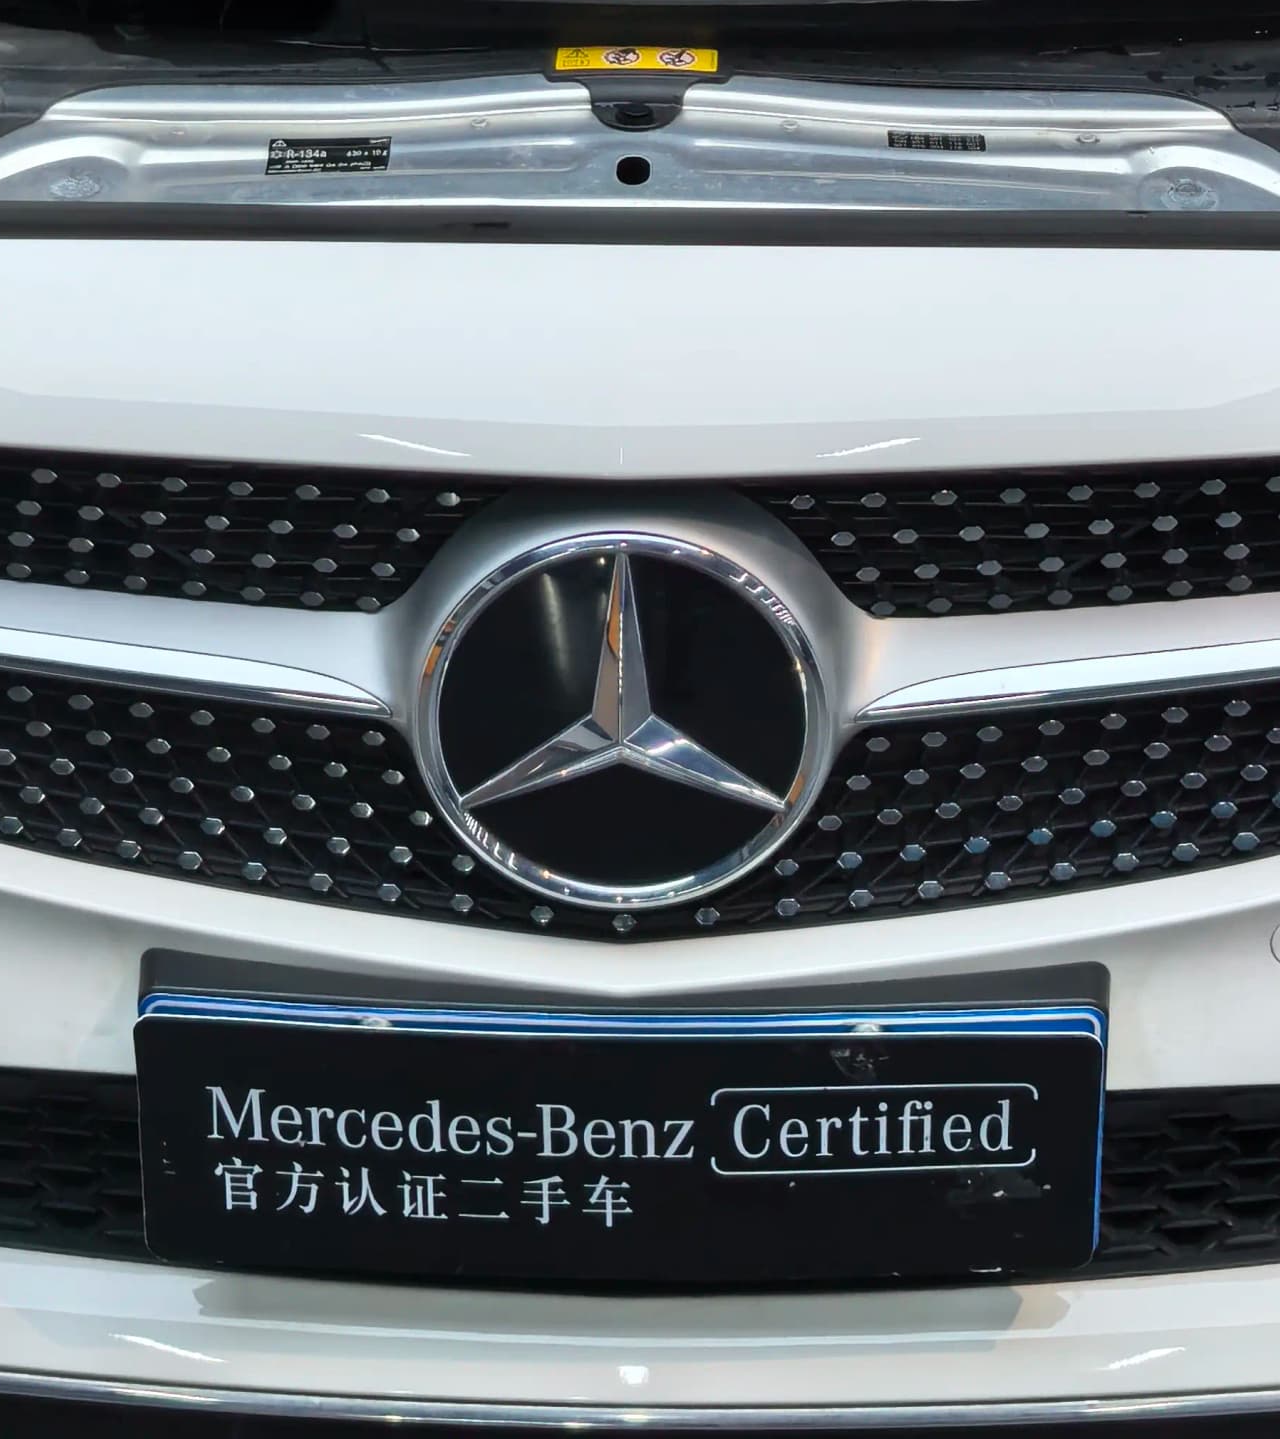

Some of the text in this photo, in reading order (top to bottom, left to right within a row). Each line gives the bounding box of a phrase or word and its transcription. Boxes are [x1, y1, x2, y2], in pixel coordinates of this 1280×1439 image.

[286, 148, 327, 159] R-134a
[205, 1086, 1013, 1161] Mercedes-Benz Certified
[214, 1158, 634, 1228] 官方认证二手车
